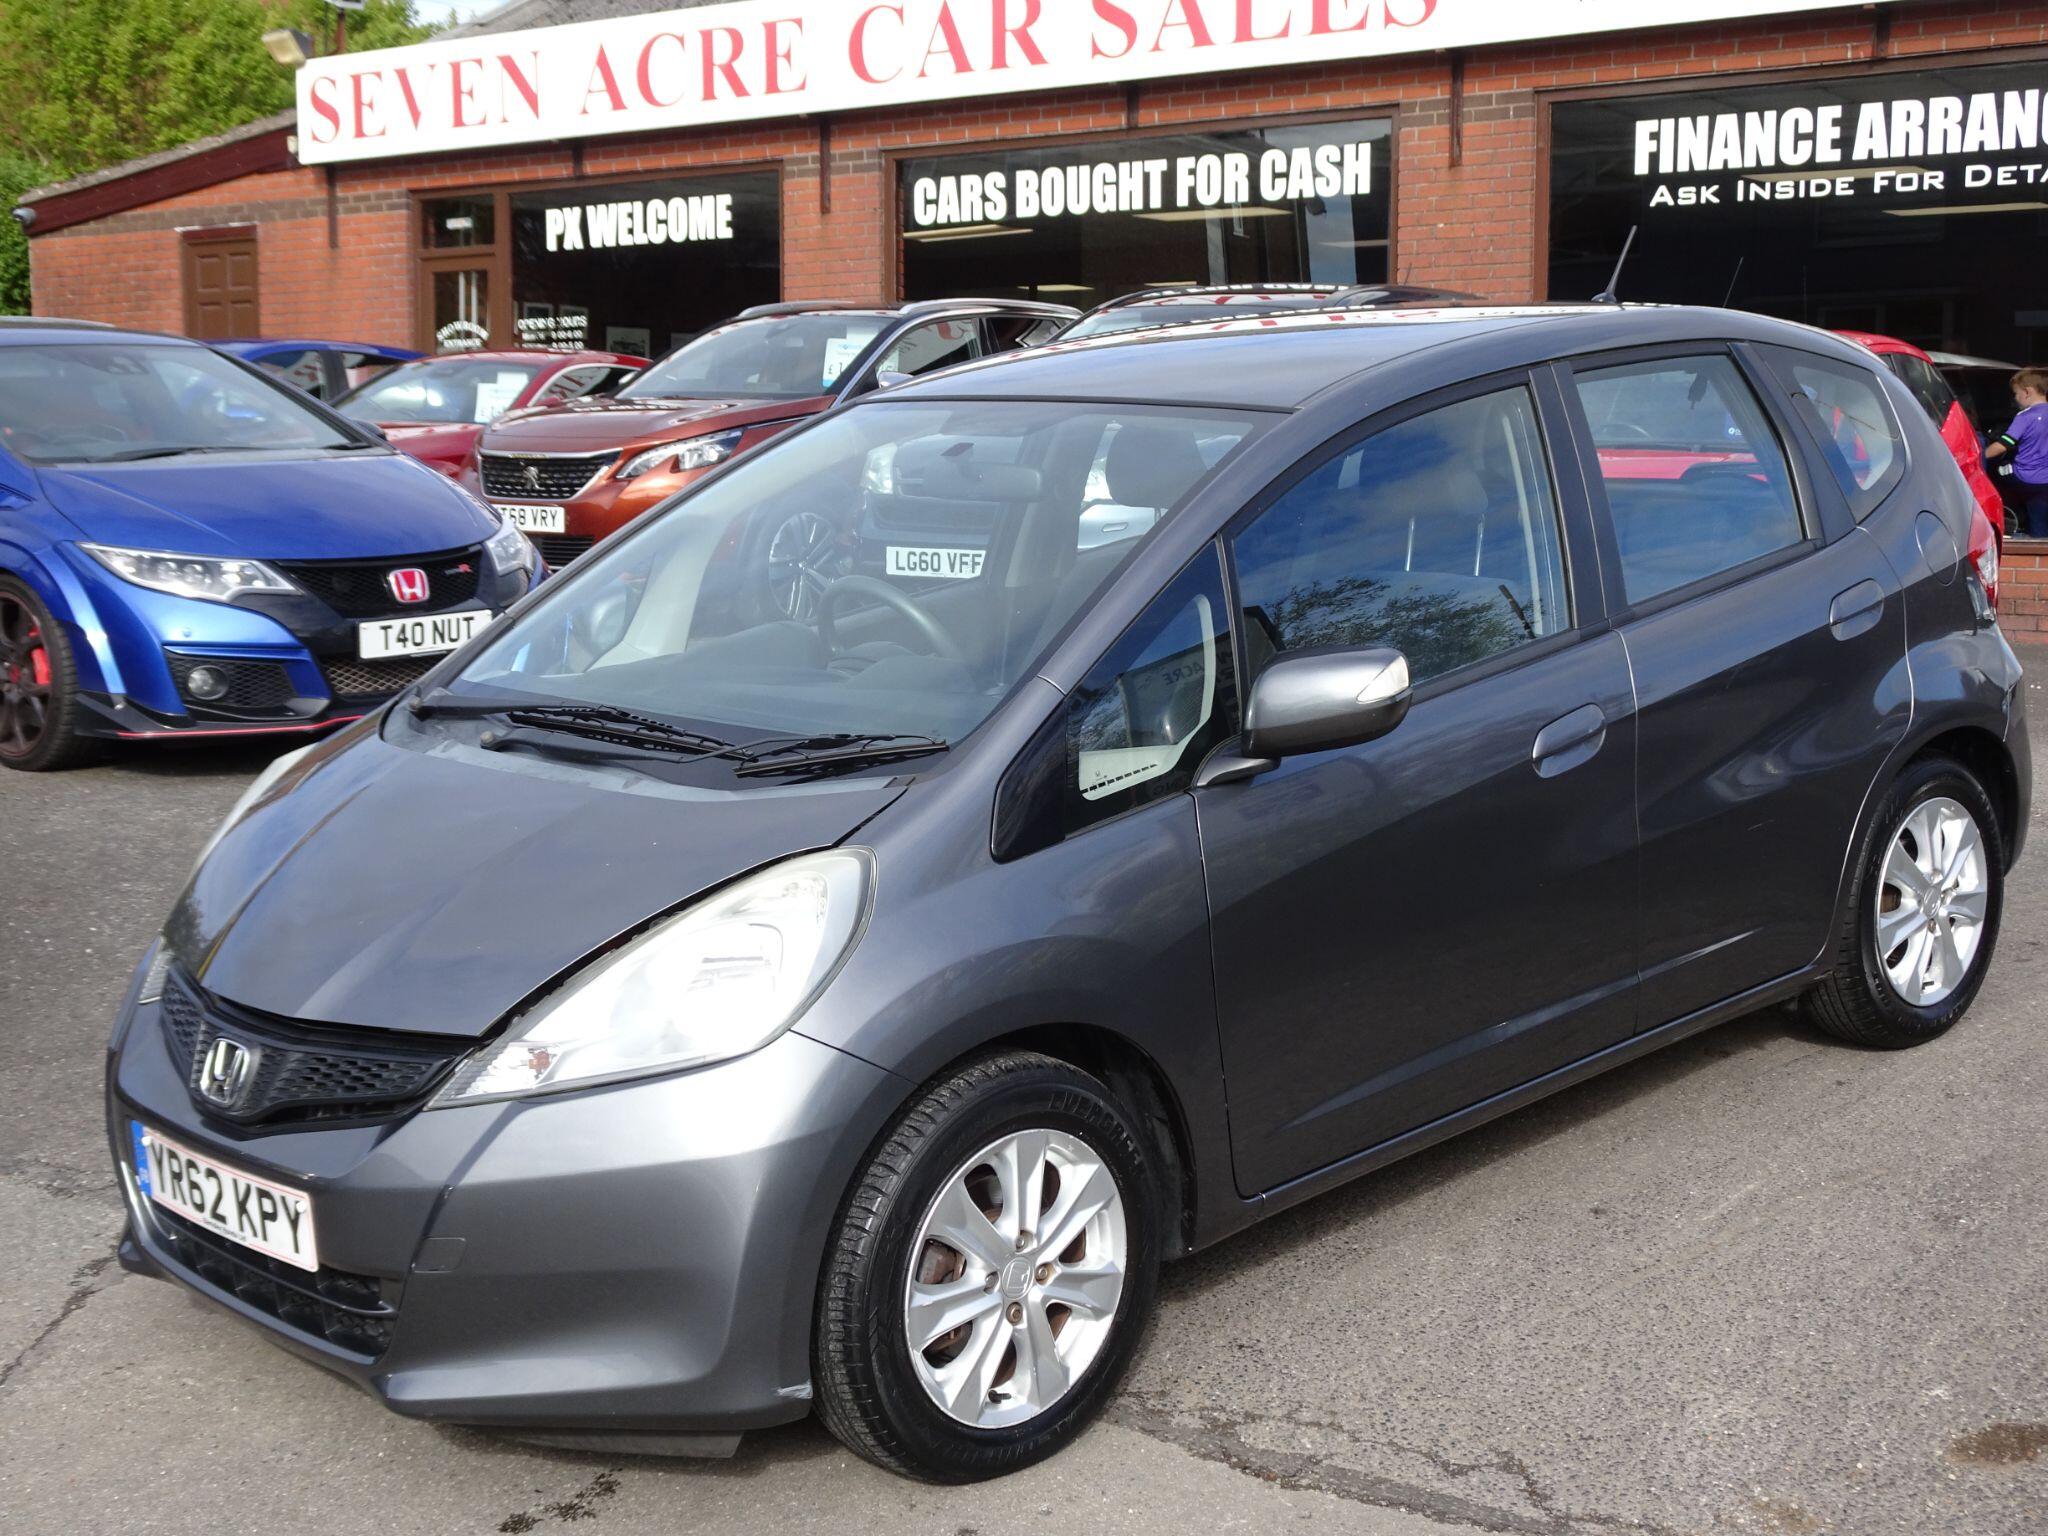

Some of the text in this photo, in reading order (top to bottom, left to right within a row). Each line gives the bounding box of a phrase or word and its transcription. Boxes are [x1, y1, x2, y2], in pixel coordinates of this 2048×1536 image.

[310, 51, 541, 144] SEVEN
[579, 17, 807, 115] ACRE
[848, 0, 1049, 84] CAR
[1633, 89, 2048, 176] FINANCE ARRAN
[913, 142, 1371, 226] CARS BOUGHT FOR CASH
[545, 193, 734, 252] PX WELCOME
[531, 508, 558, 528] VRY
[895, 550, 982, 574] LG60 VFF
[379, 616, 475, 651] T40 NUT
[149, 1140, 301, 1254] YR62 KPY
